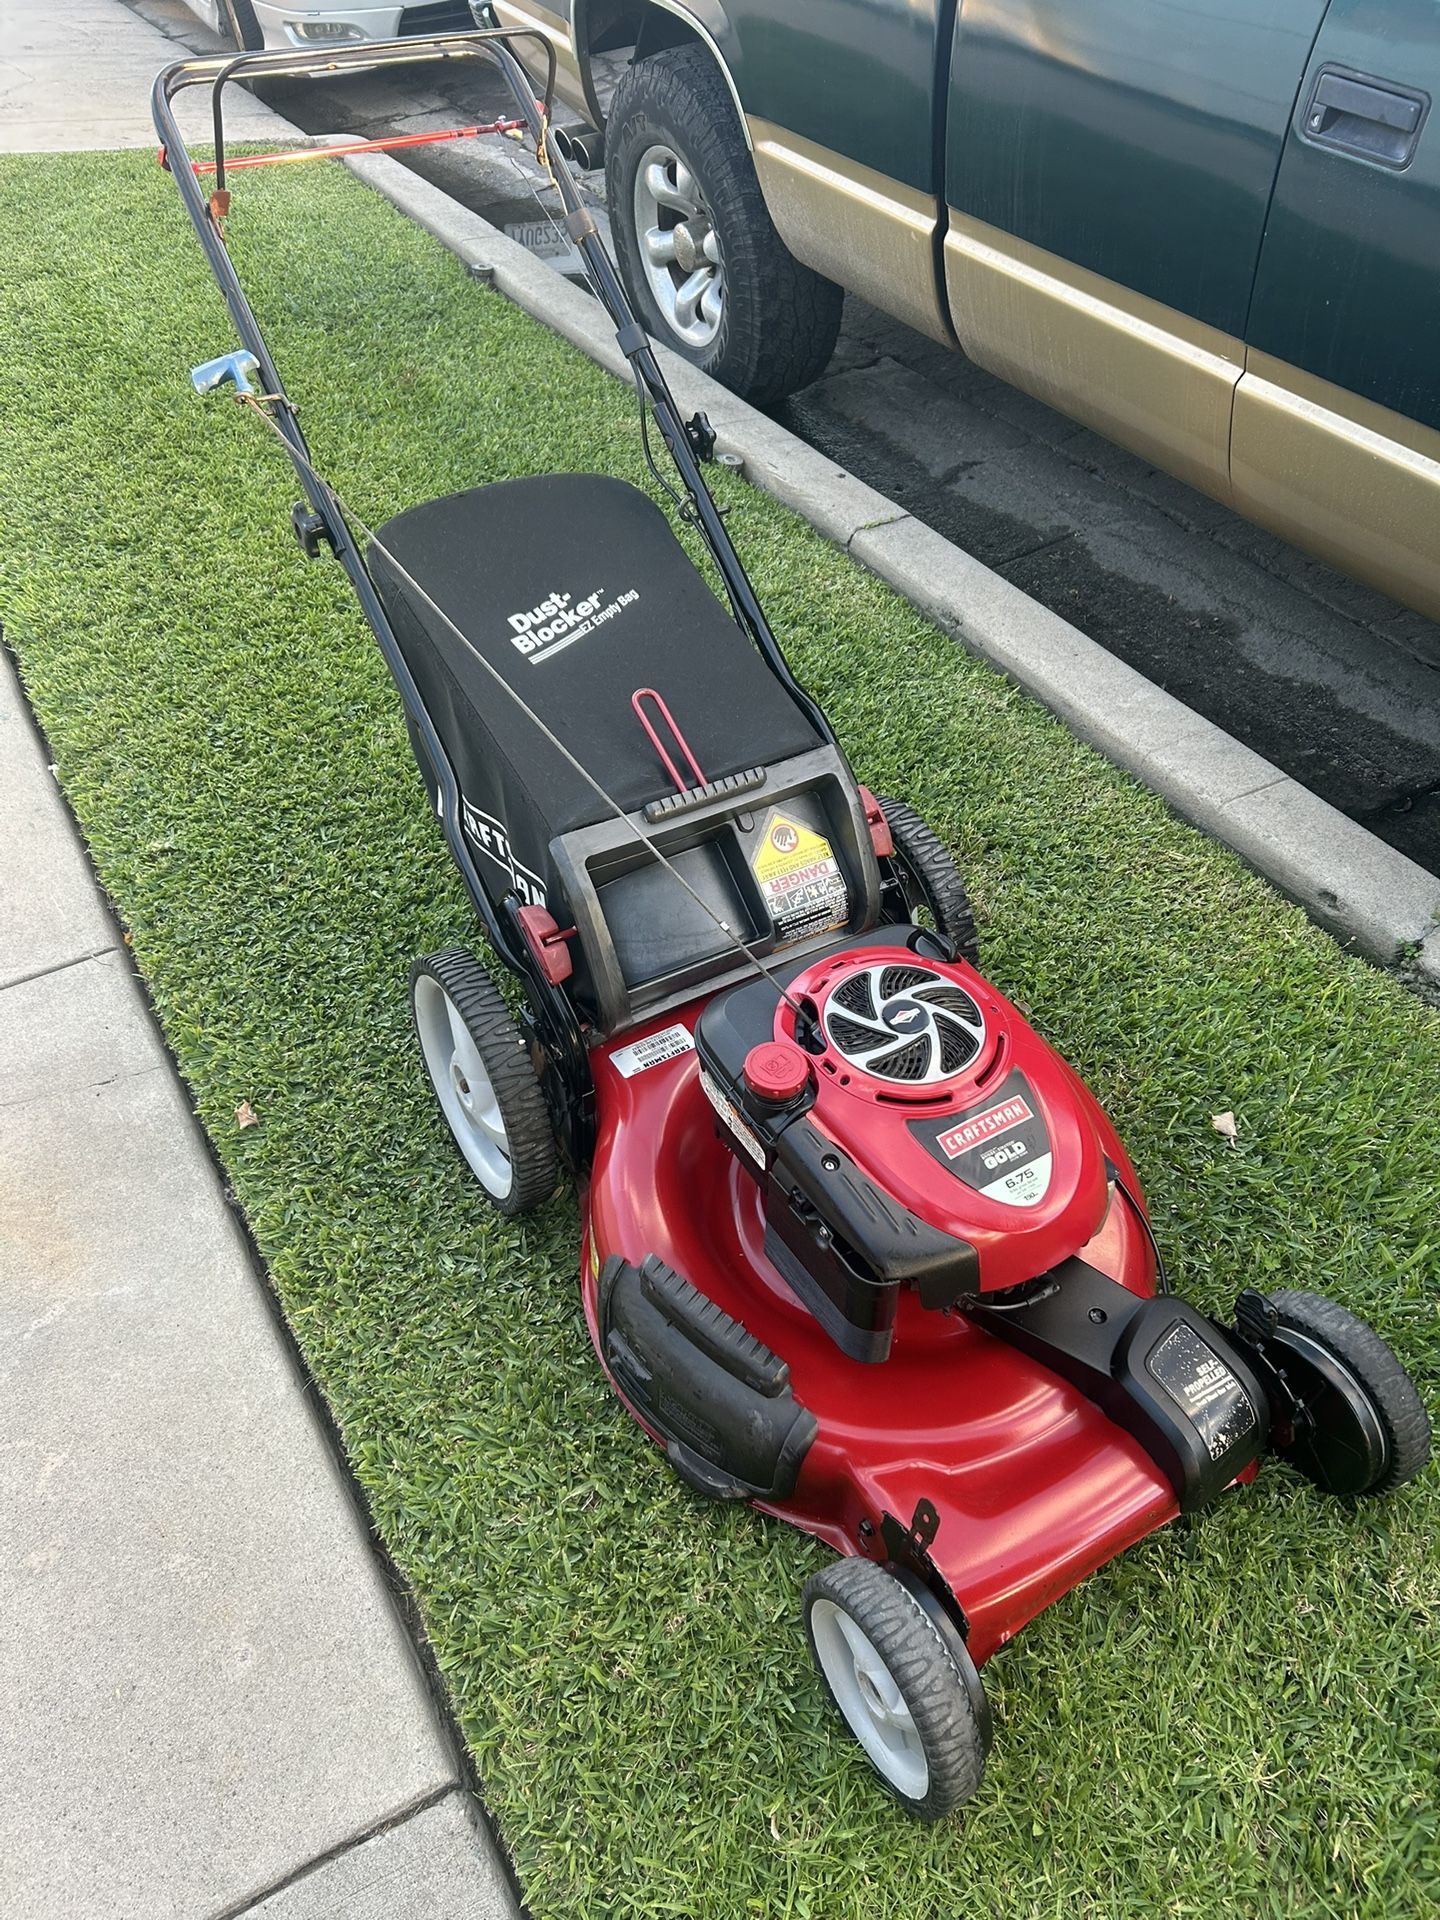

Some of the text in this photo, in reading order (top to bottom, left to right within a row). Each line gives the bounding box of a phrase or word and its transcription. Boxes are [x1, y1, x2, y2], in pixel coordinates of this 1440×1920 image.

[507, 592, 572, 634] Dust-
[579, 589, 640, 634] EZ Empty Bag
[770, 862, 829, 892] DANGER
[643, 1044, 690, 1068] CRAFTSMAN
[945, 1103, 1024, 1150] CRAFTSMAN
[984, 1141, 1026, 1170] GOLD
[1005, 1168, 1034, 1189] 6.75
[1183, 1366, 1227, 1397] PROPELLED
[1196, 1359, 1219, 1376] SELF-
